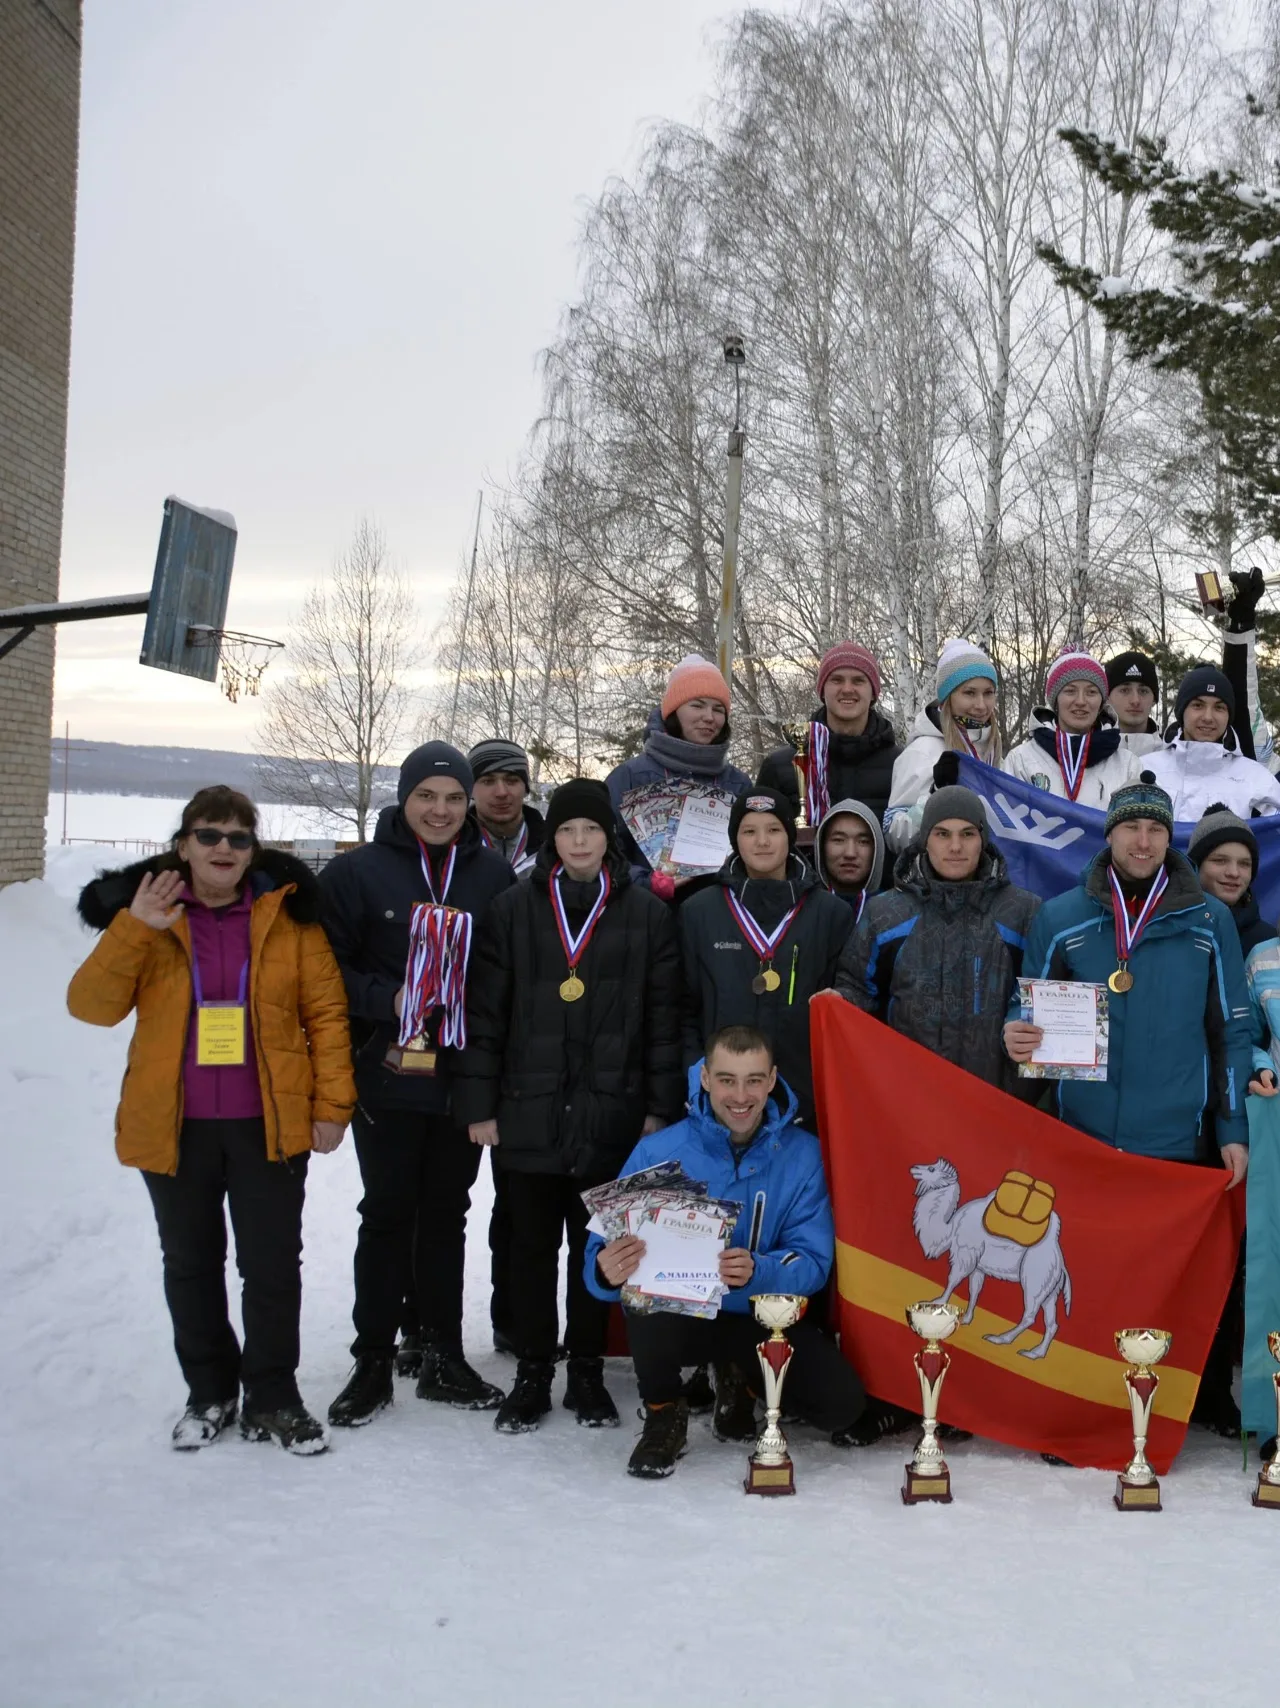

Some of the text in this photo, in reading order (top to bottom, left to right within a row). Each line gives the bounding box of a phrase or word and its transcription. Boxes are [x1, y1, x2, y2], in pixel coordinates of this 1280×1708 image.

[1039, 991, 1089, 999] ГРАМОТА
[663, 1218, 713, 1234] ГРАМОТА
[666, 1271, 719, 1279] МАНАРАГА
